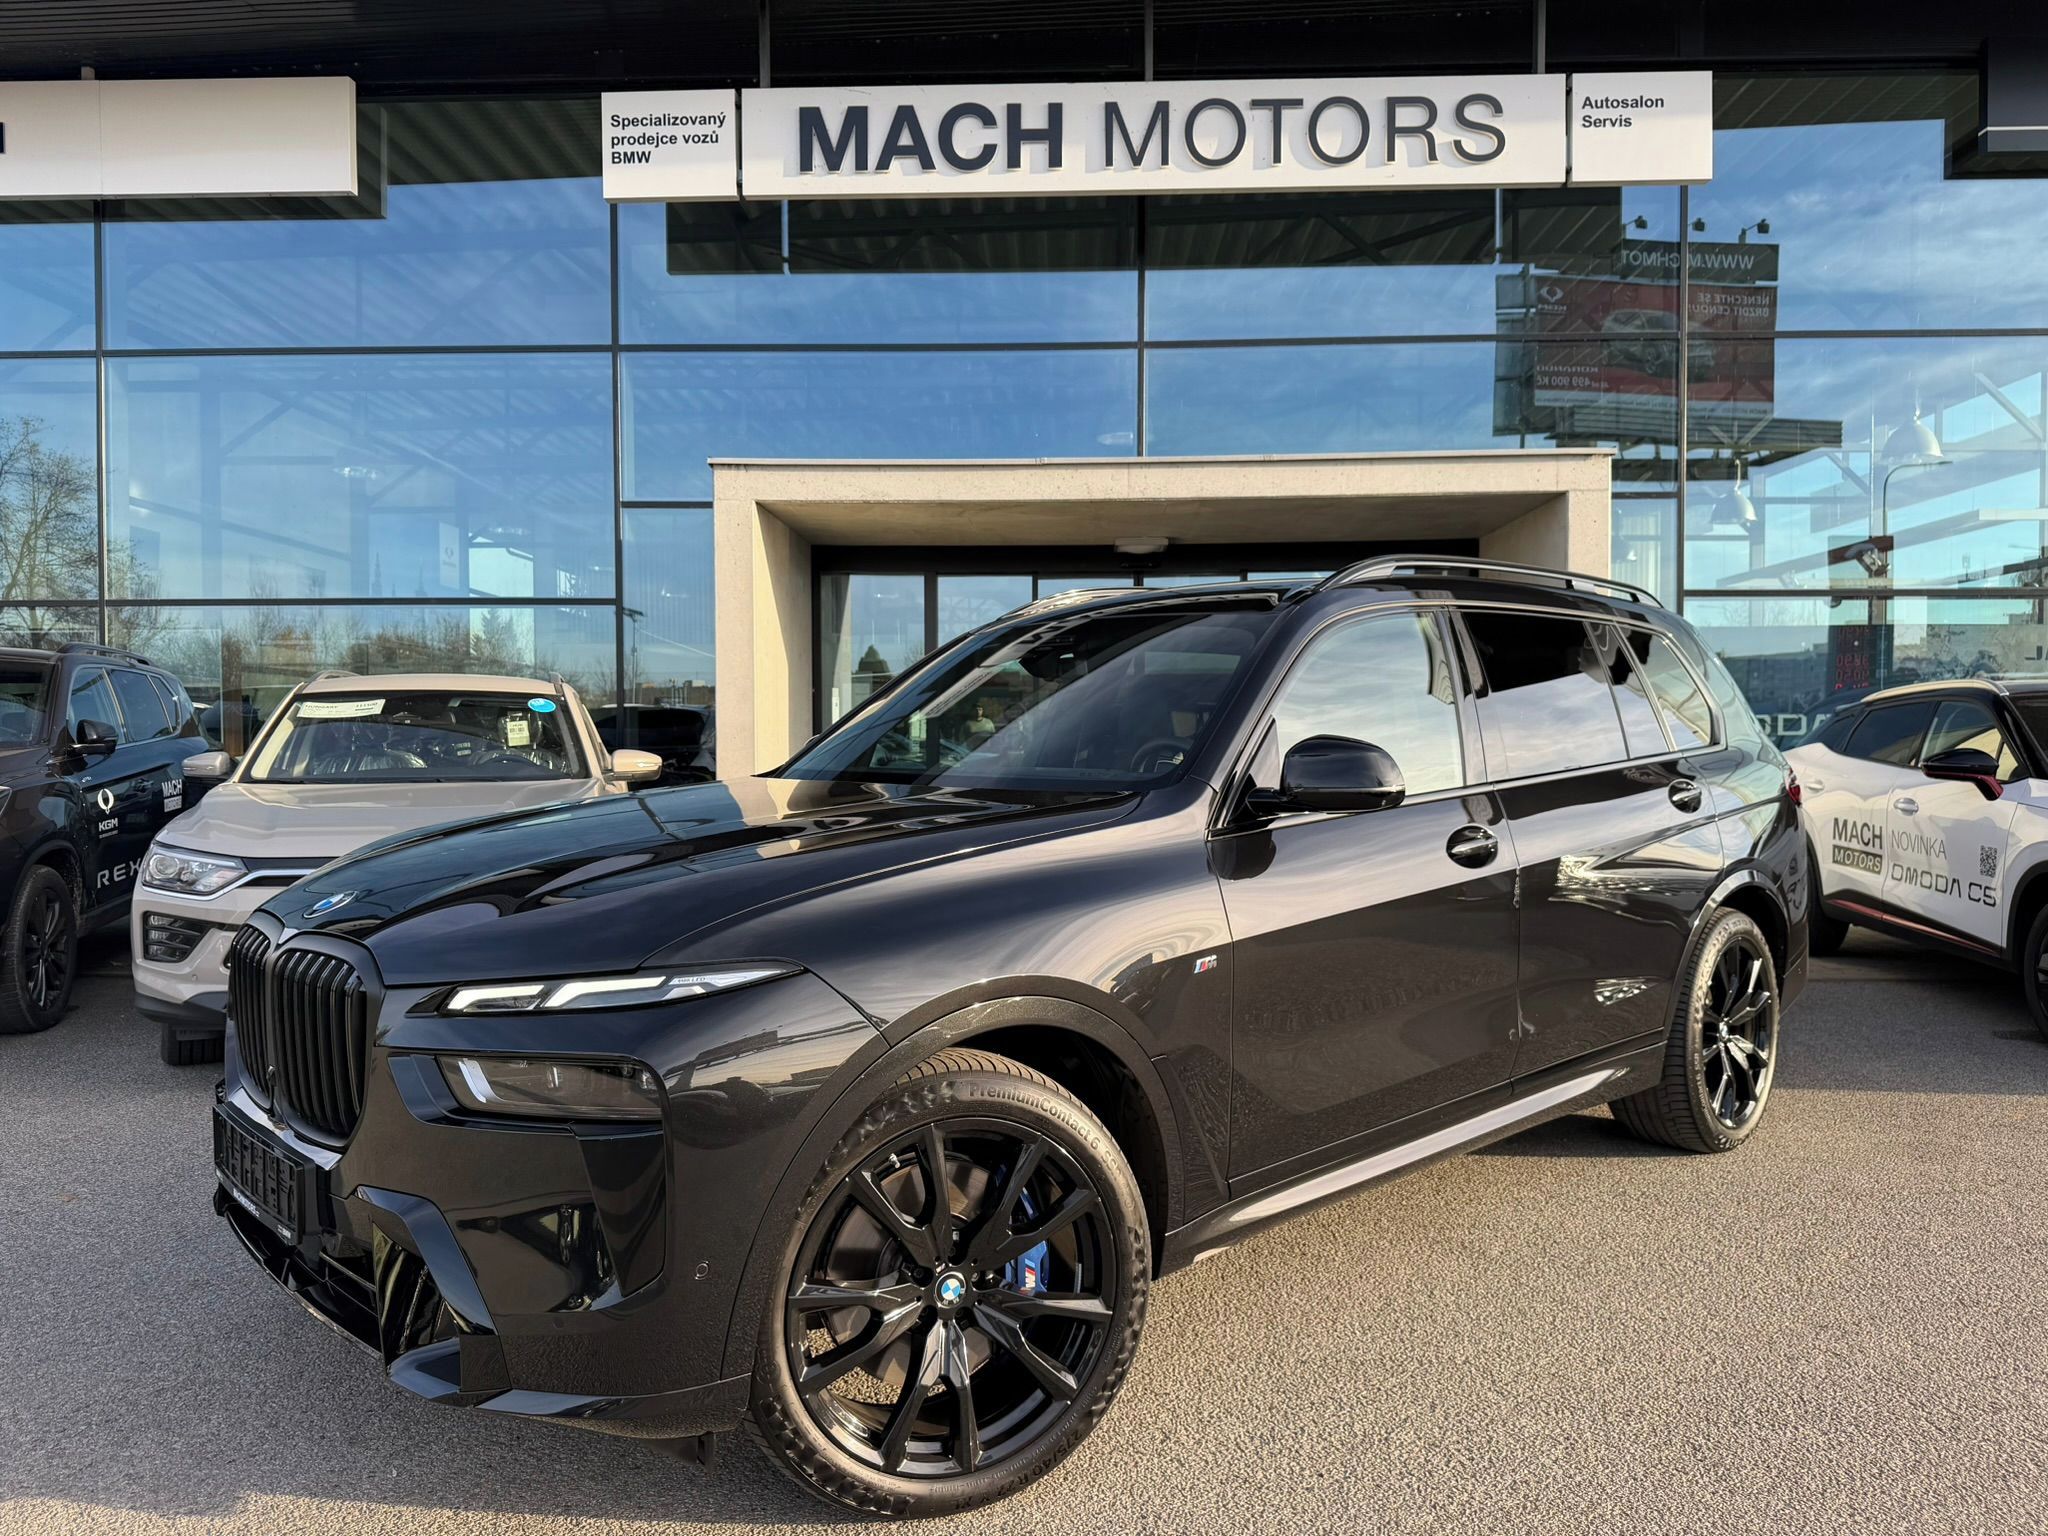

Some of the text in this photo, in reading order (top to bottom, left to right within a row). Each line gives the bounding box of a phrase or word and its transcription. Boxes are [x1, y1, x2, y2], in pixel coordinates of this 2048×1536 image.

[1581, 94, 1665, 110] Autosalon
[610, 111, 727, 131] Specializovaný
[1581, 113, 1633, 128] Servis
[610, 130, 720, 149] prodejce vozů
[798, 93, 1507, 173] MACH MOTORS
[611, 149, 652, 164] BMW
[161, 778, 182, 798] MACH
[98, 817, 119, 832] KGM
[1832, 817, 1883, 850] MACH
[1891, 830, 1947, 860] NOVINKA
[1833, 849, 1882, 873] MOTORS
[1891, 863, 1997, 908] OMODA C5
[969, 1083, 1093, 1142] PremiumContact
[1090, 1136, 1101, 1150] 6
